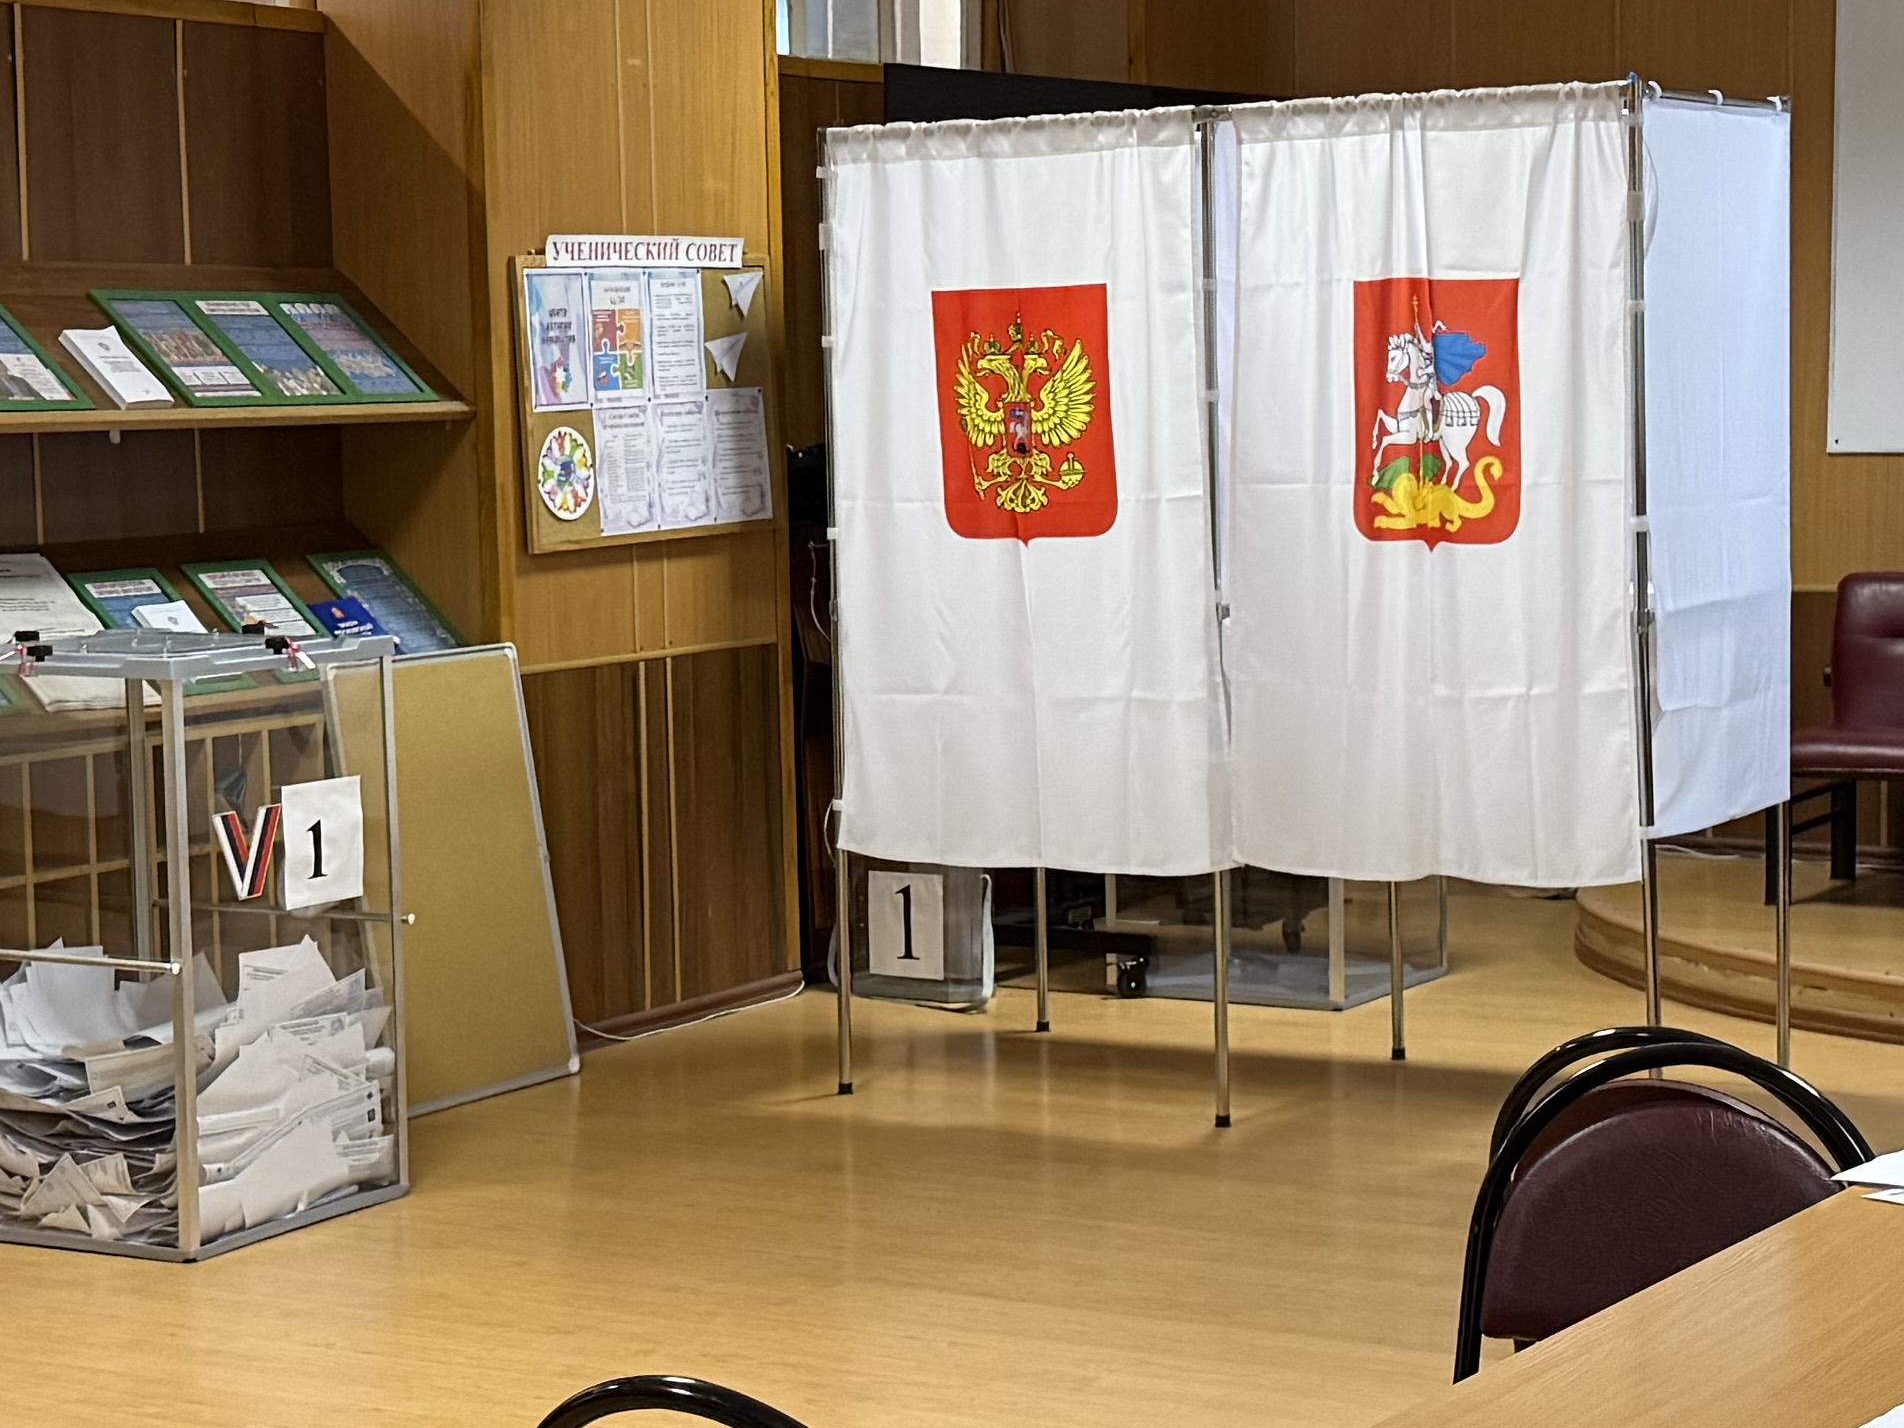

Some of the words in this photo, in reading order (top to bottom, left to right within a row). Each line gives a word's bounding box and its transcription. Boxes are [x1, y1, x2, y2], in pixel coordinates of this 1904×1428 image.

[553, 238, 681, 262] УЧЕНИЧЕСКИЙ
[686, 242, 738, 263] СОВЕТ
[306, 819, 328, 879] 1
[894, 884, 920, 961] 1
